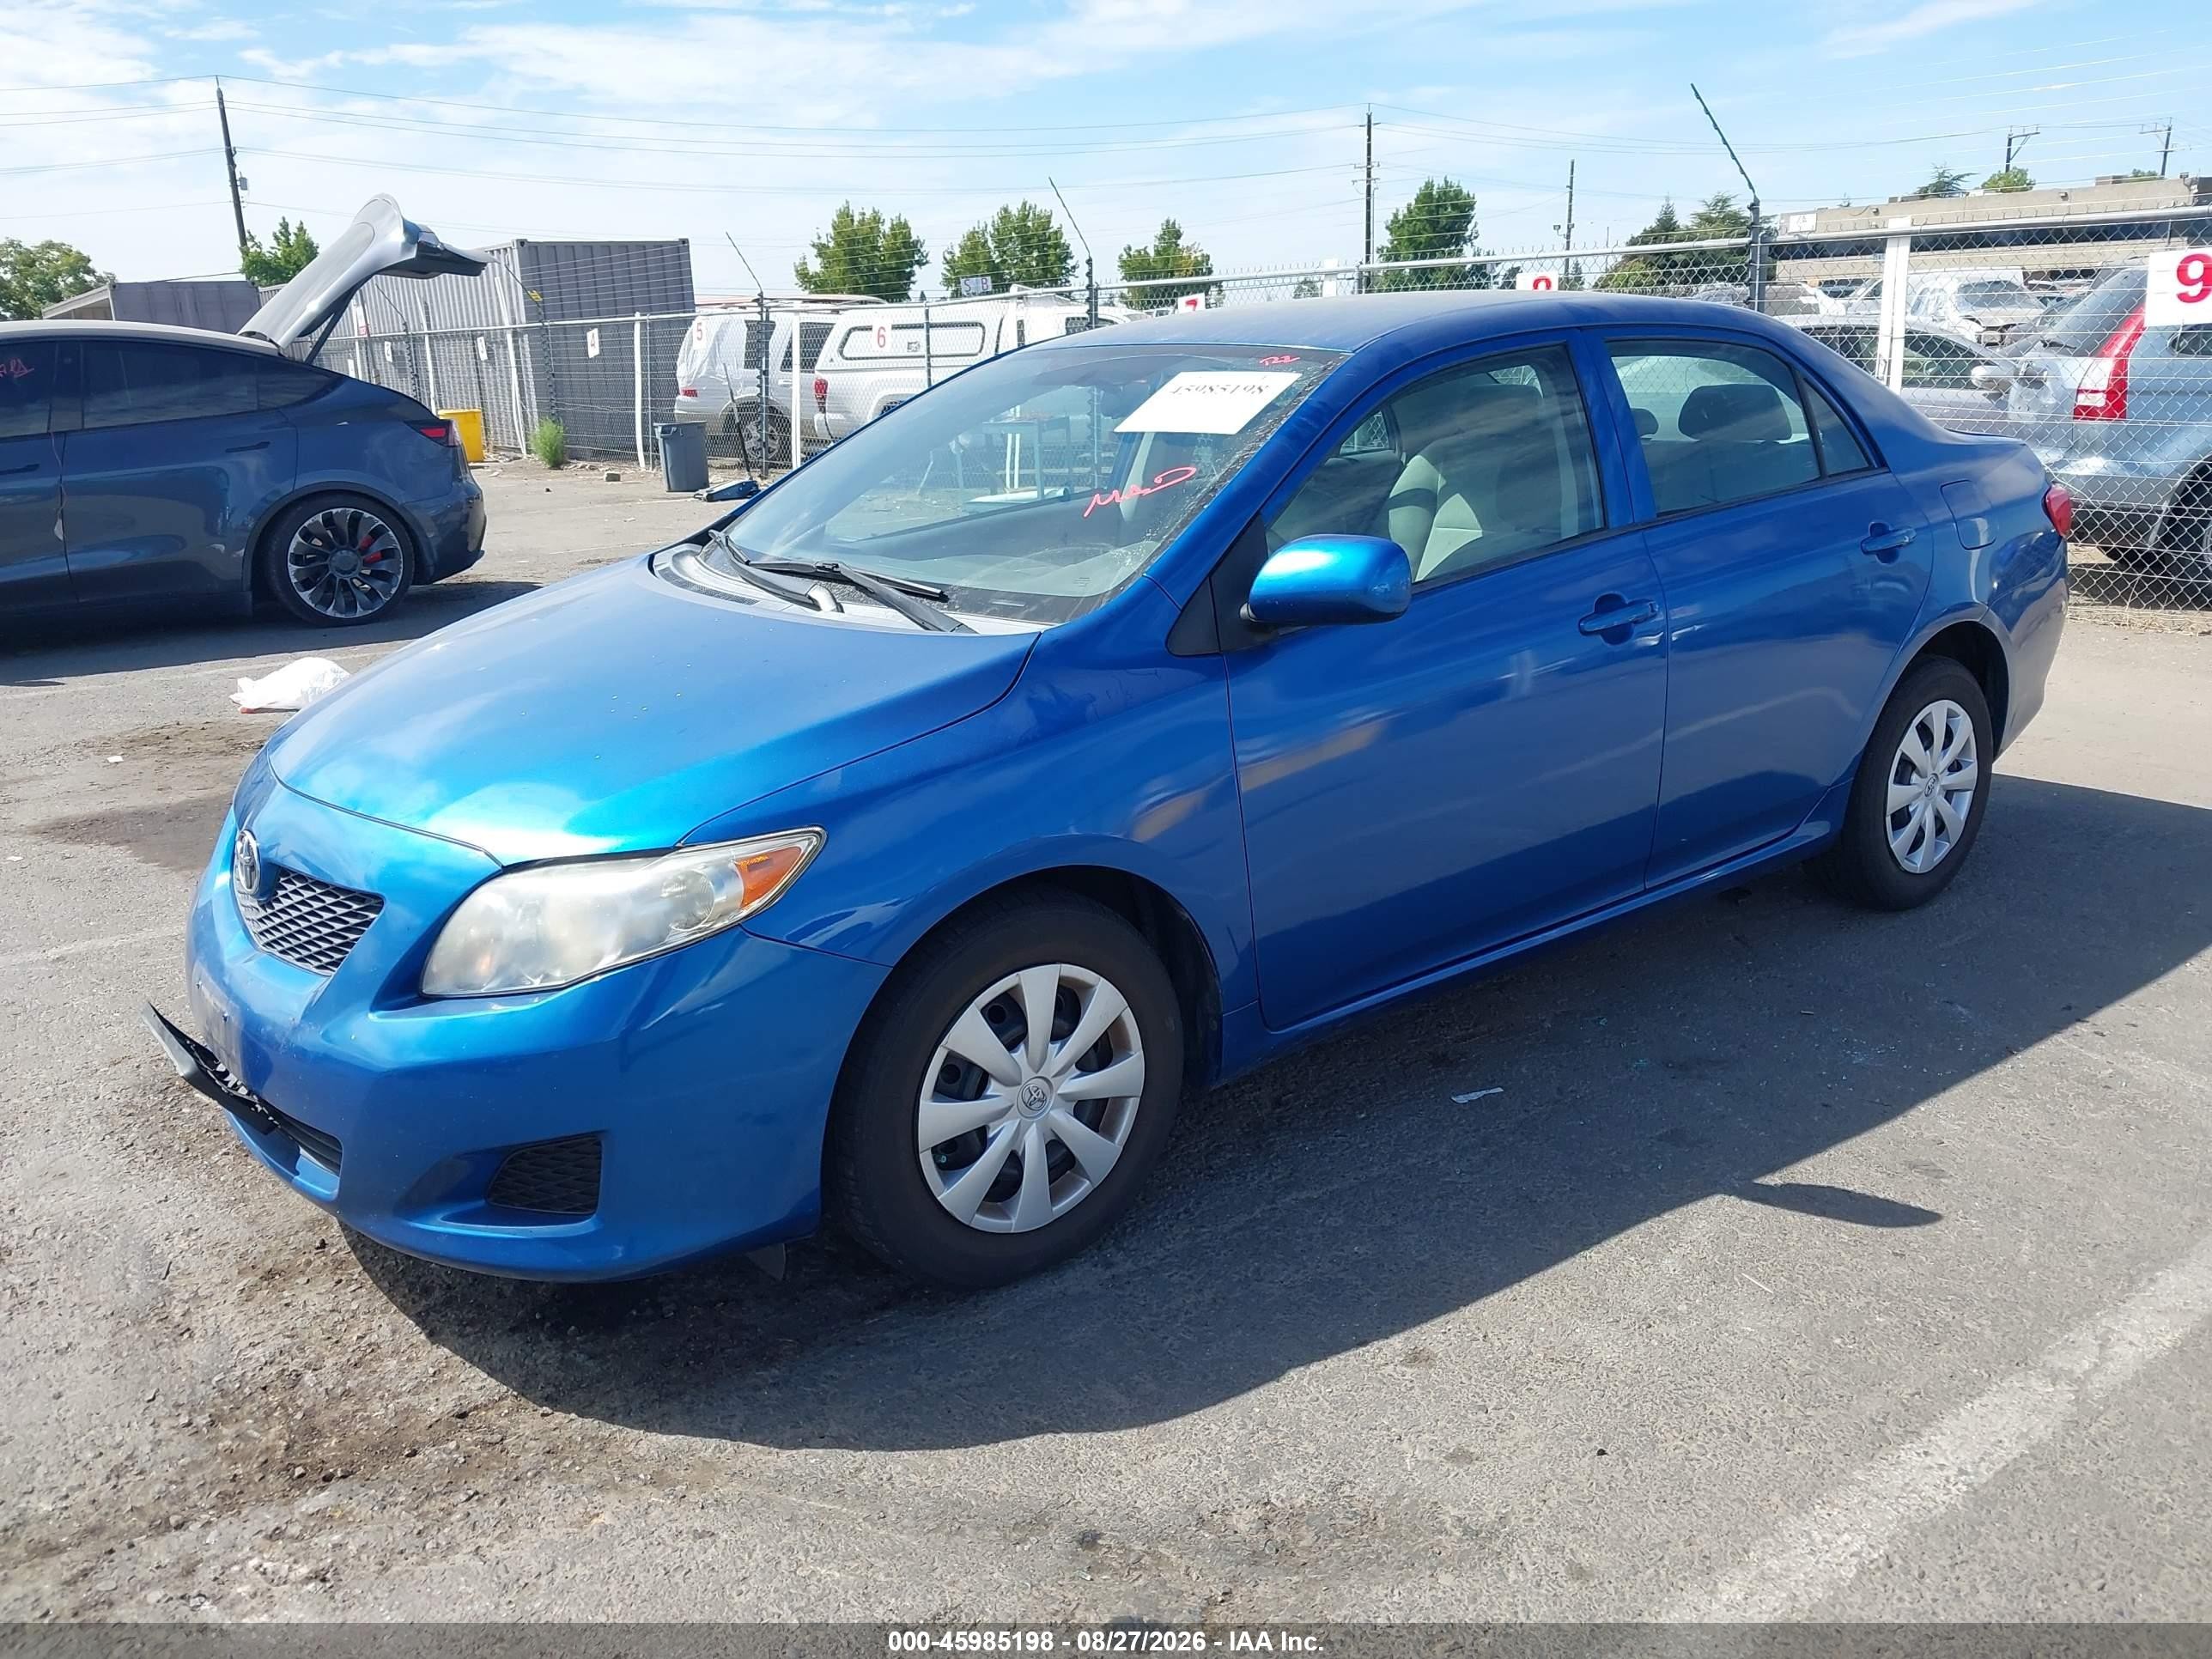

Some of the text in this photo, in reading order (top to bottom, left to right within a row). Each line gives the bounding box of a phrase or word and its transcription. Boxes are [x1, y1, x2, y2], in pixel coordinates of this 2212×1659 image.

[963, 277, 989, 293] S B
[2177, 253, 2212, 304] 9
[696, 322, 703, 341] 5
[877, 325, 886, 349] 6
